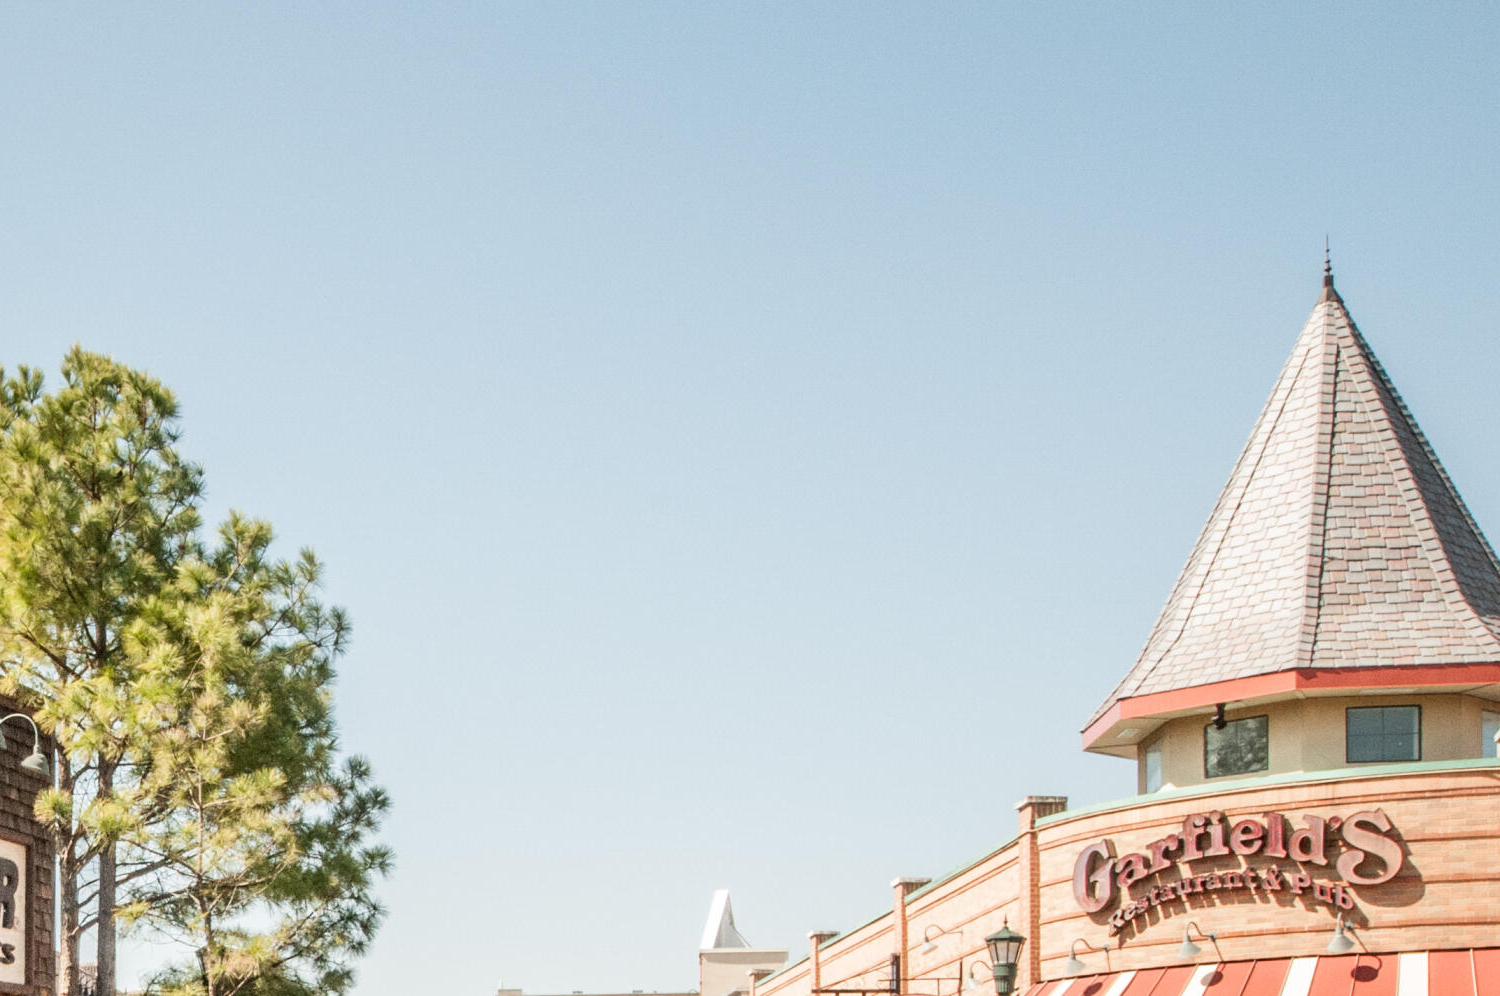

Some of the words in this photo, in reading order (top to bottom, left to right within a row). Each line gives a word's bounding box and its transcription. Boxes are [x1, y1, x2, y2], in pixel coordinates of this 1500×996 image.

[1107, 867, 1257, 938] Restaurant
[1261, 864, 1283, 891] &
[1290, 871, 1354, 910] Pub
